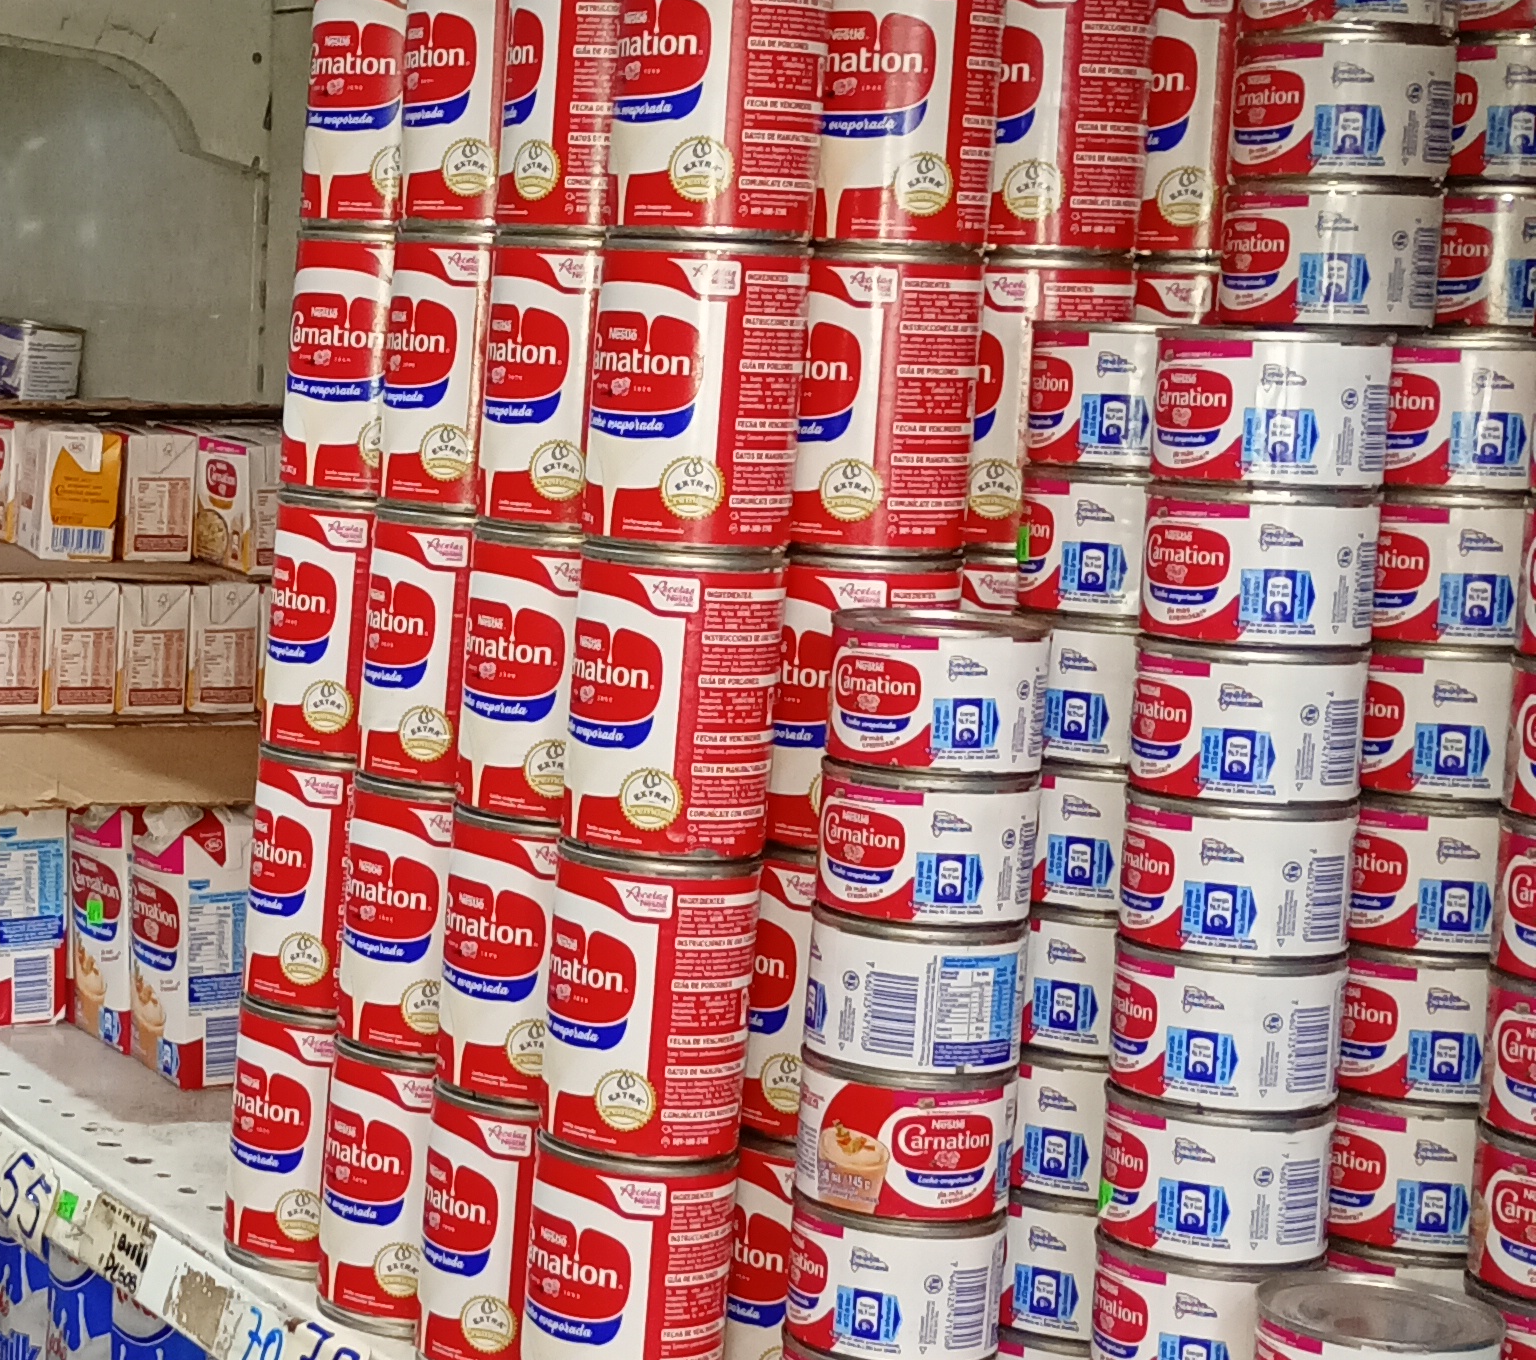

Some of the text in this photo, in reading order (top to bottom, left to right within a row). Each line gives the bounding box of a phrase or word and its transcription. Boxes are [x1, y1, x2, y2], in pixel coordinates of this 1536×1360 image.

[290, 310, 378, 353] Carnation
[608, 328, 638, 342] Nestlé
[1156, 376, 1227, 412] Carnation
[1148, 531, 1225, 568] Carnation
[837, 660, 916, 697] Carnation
[634, 788, 670, 801] EXTRA
[824, 813, 900, 850] Carnation
[898, 1124, 990, 1156] Carnation
[932, 1119, 965, 1130] Nestlé
